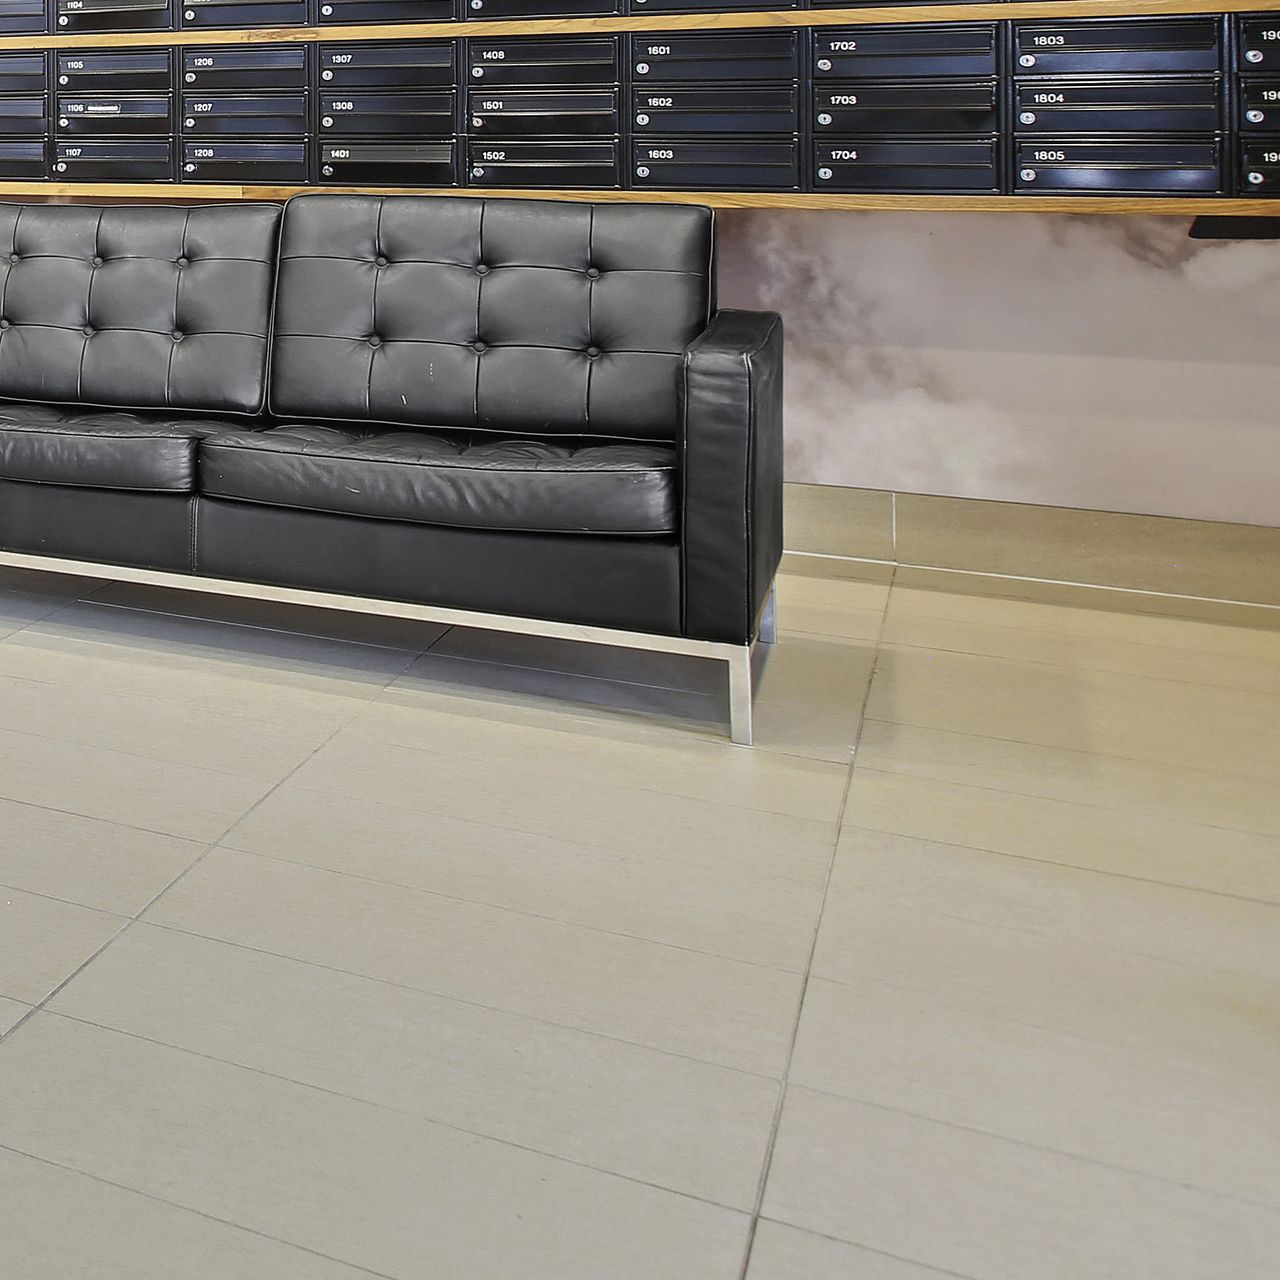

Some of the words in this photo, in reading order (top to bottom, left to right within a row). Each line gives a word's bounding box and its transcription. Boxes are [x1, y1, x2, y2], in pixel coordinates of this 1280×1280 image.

[66, 1, 83, 9] 1104
[1033, 35, 1065, 46] 1803
[647, 46, 670, 55] 1601
[829, 41, 856, 51] 1702
[331, 54, 353, 64] 1307
[482, 50, 505, 60] 1408
[67, 60, 84, 69] 1105
[194, 57, 214, 67] 1206
[647, 97, 673, 107] 1602
[830, 95, 857, 105] 1703
[1033, 93, 1065, 103] 1804
[67, 104, 84, 112] 1106
[193, 103, 213, 112] 1207
[332, 101, 354, 110] 1308
[482, 101, 503, 110] 1501
[65, 148, 82, 157] 1107
[194, 148, 214, 157] 1208
[330, 149, 350, 158] 1401
[482, 151, 506, 160] 1502
[648, 149, 674, 159] 1603
[831, 150, 857, 160] 1704
[1033, 150, 1065, 161] 1805
[1263, 152, 1280, 162] 19
